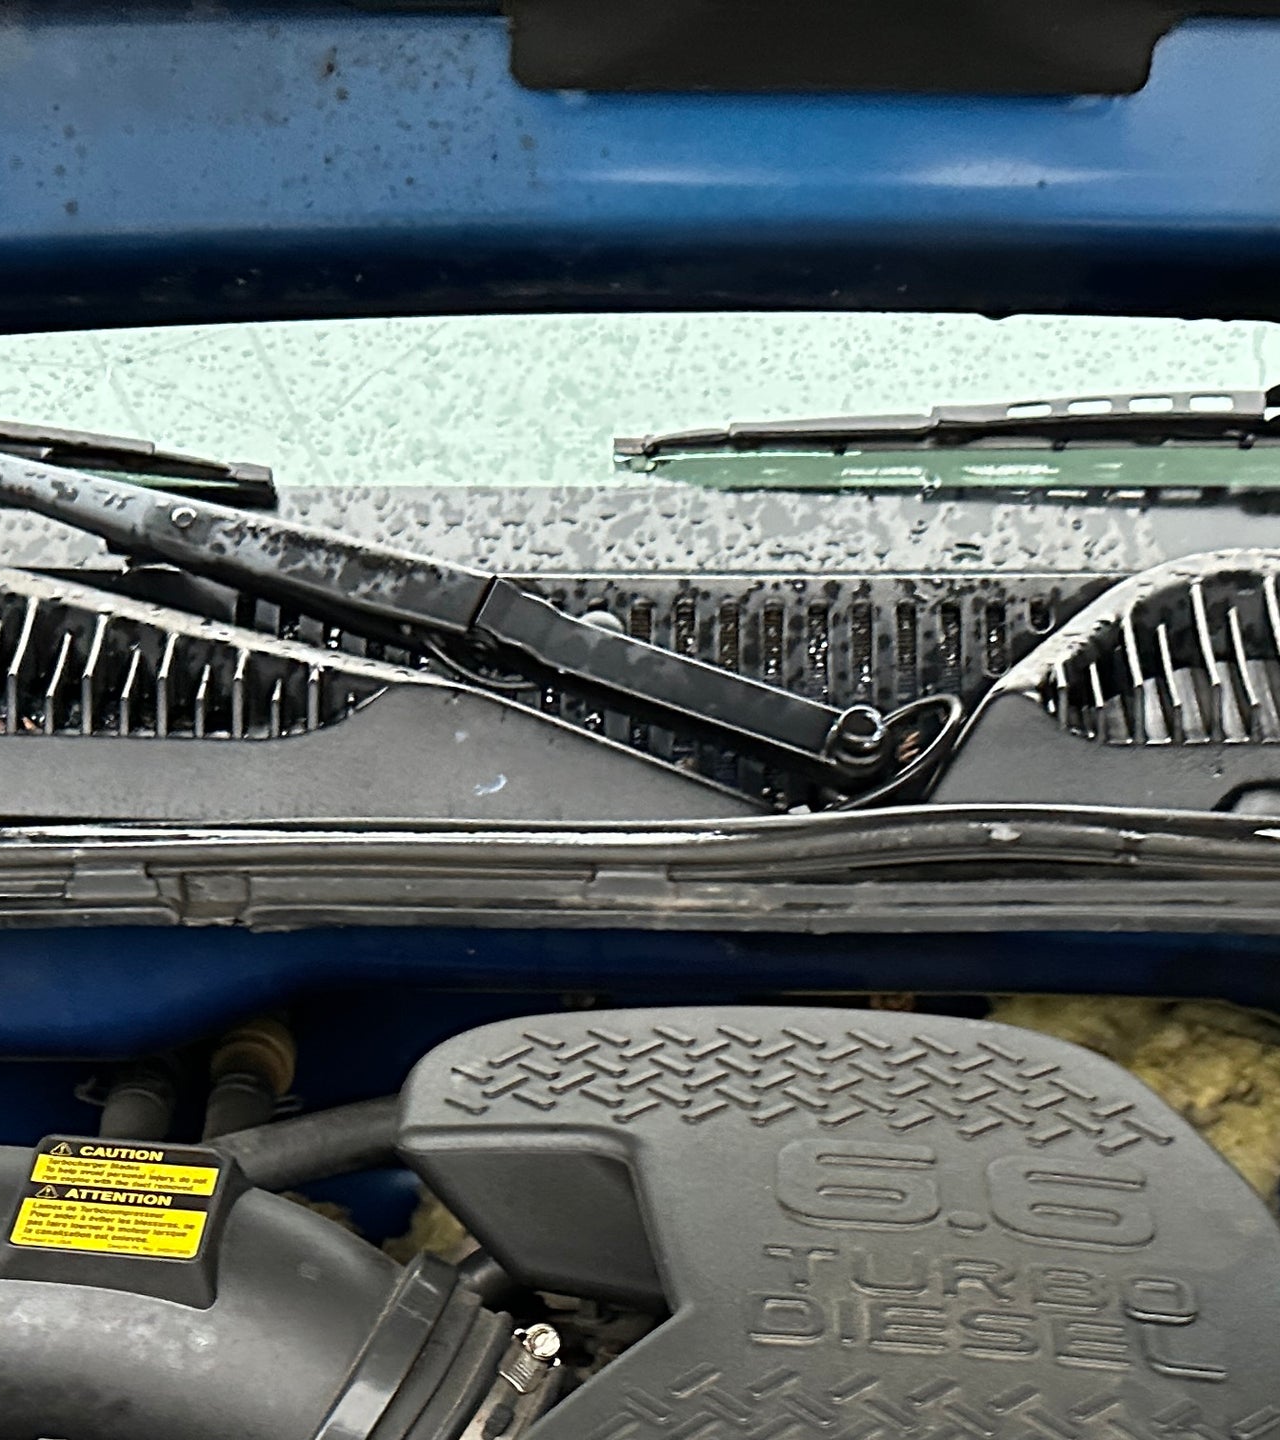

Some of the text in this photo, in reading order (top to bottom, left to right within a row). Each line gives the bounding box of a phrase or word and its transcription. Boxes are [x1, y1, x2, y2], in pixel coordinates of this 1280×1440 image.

[80, 1146, 164, 1162] CAUTION
[58, 1166, 77, 1176] help
[80, 1168, 105, 1177] avoid
[107, 1171, 147, 1181] personal
[93, 1176, 112, 1185] with
[64, 1188, 172, 1206] ATTENTION
[776, 1138, 1158, 1254] 6.6
[763, 1243, 1198, 1328] TURBO
[747, 1296, 1229, 1383] DIESEL
